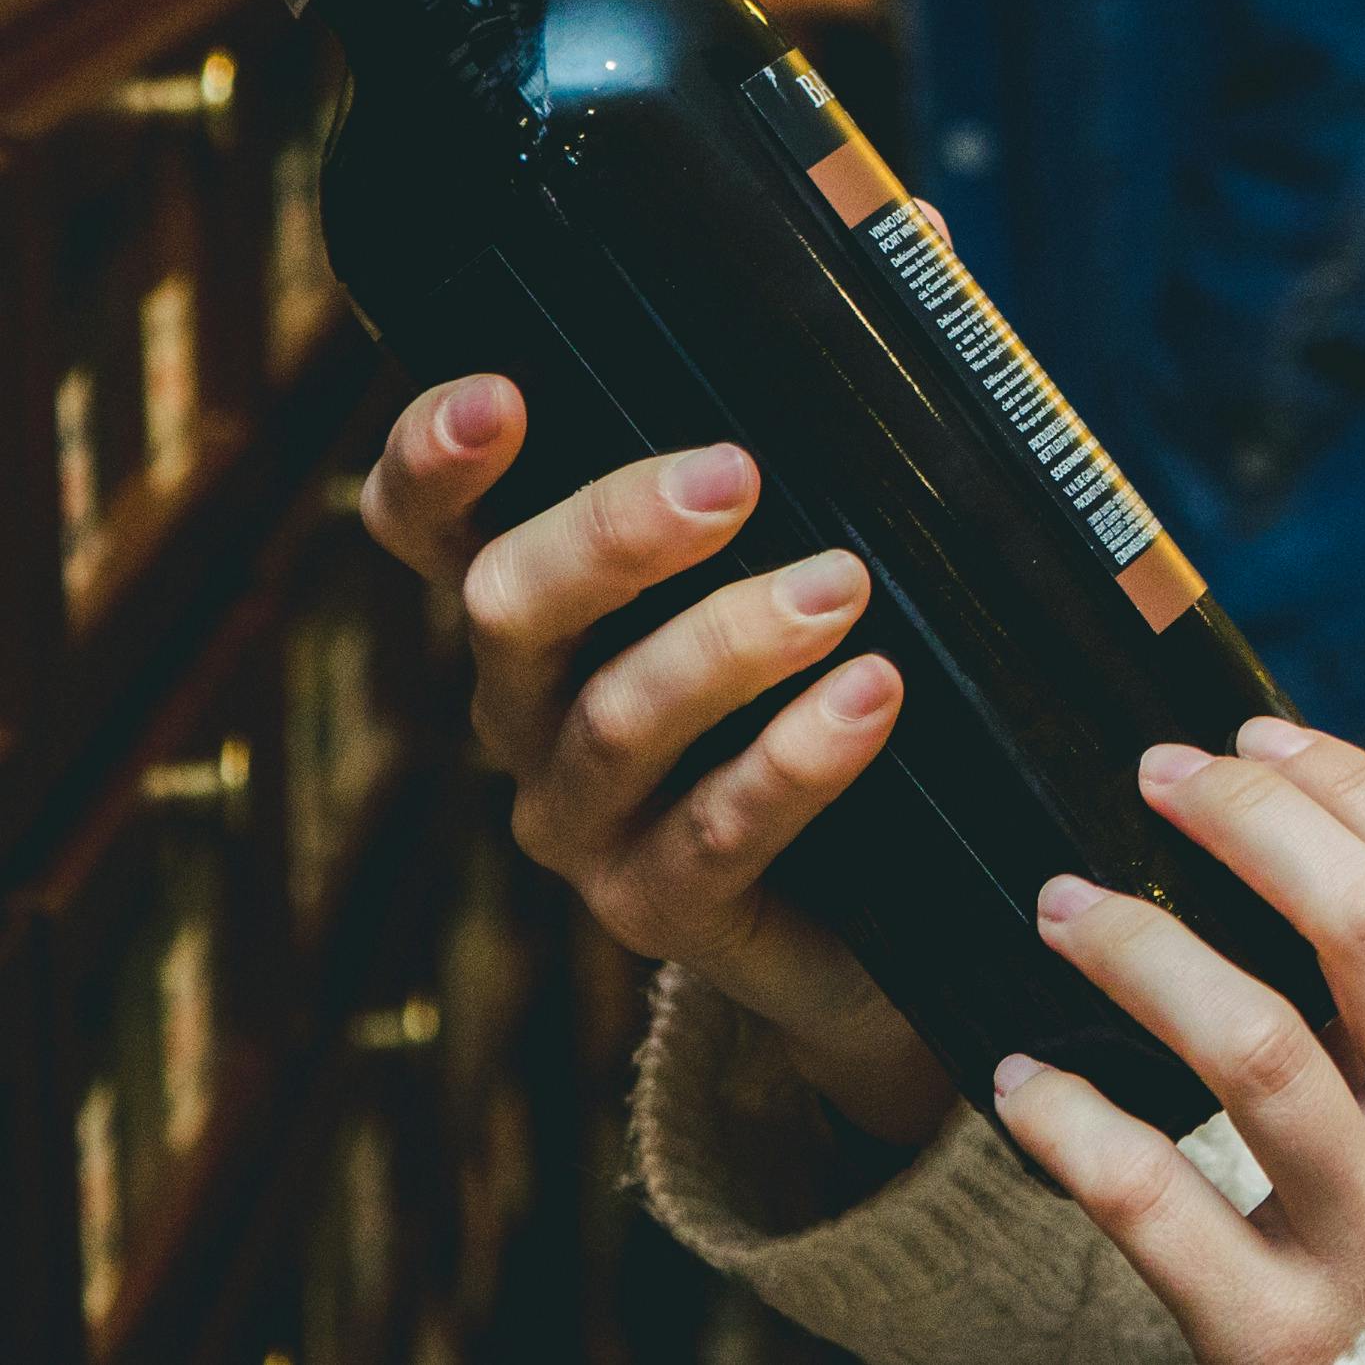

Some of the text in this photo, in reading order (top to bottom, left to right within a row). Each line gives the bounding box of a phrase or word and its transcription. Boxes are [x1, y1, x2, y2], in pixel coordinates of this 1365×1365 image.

[869, 215, 896, 239] VINHO
[892, 209, 906, 223] DO
[879, 231, 902, 253] PORT
[1038, 438, 1065, 464] BOTTLED
